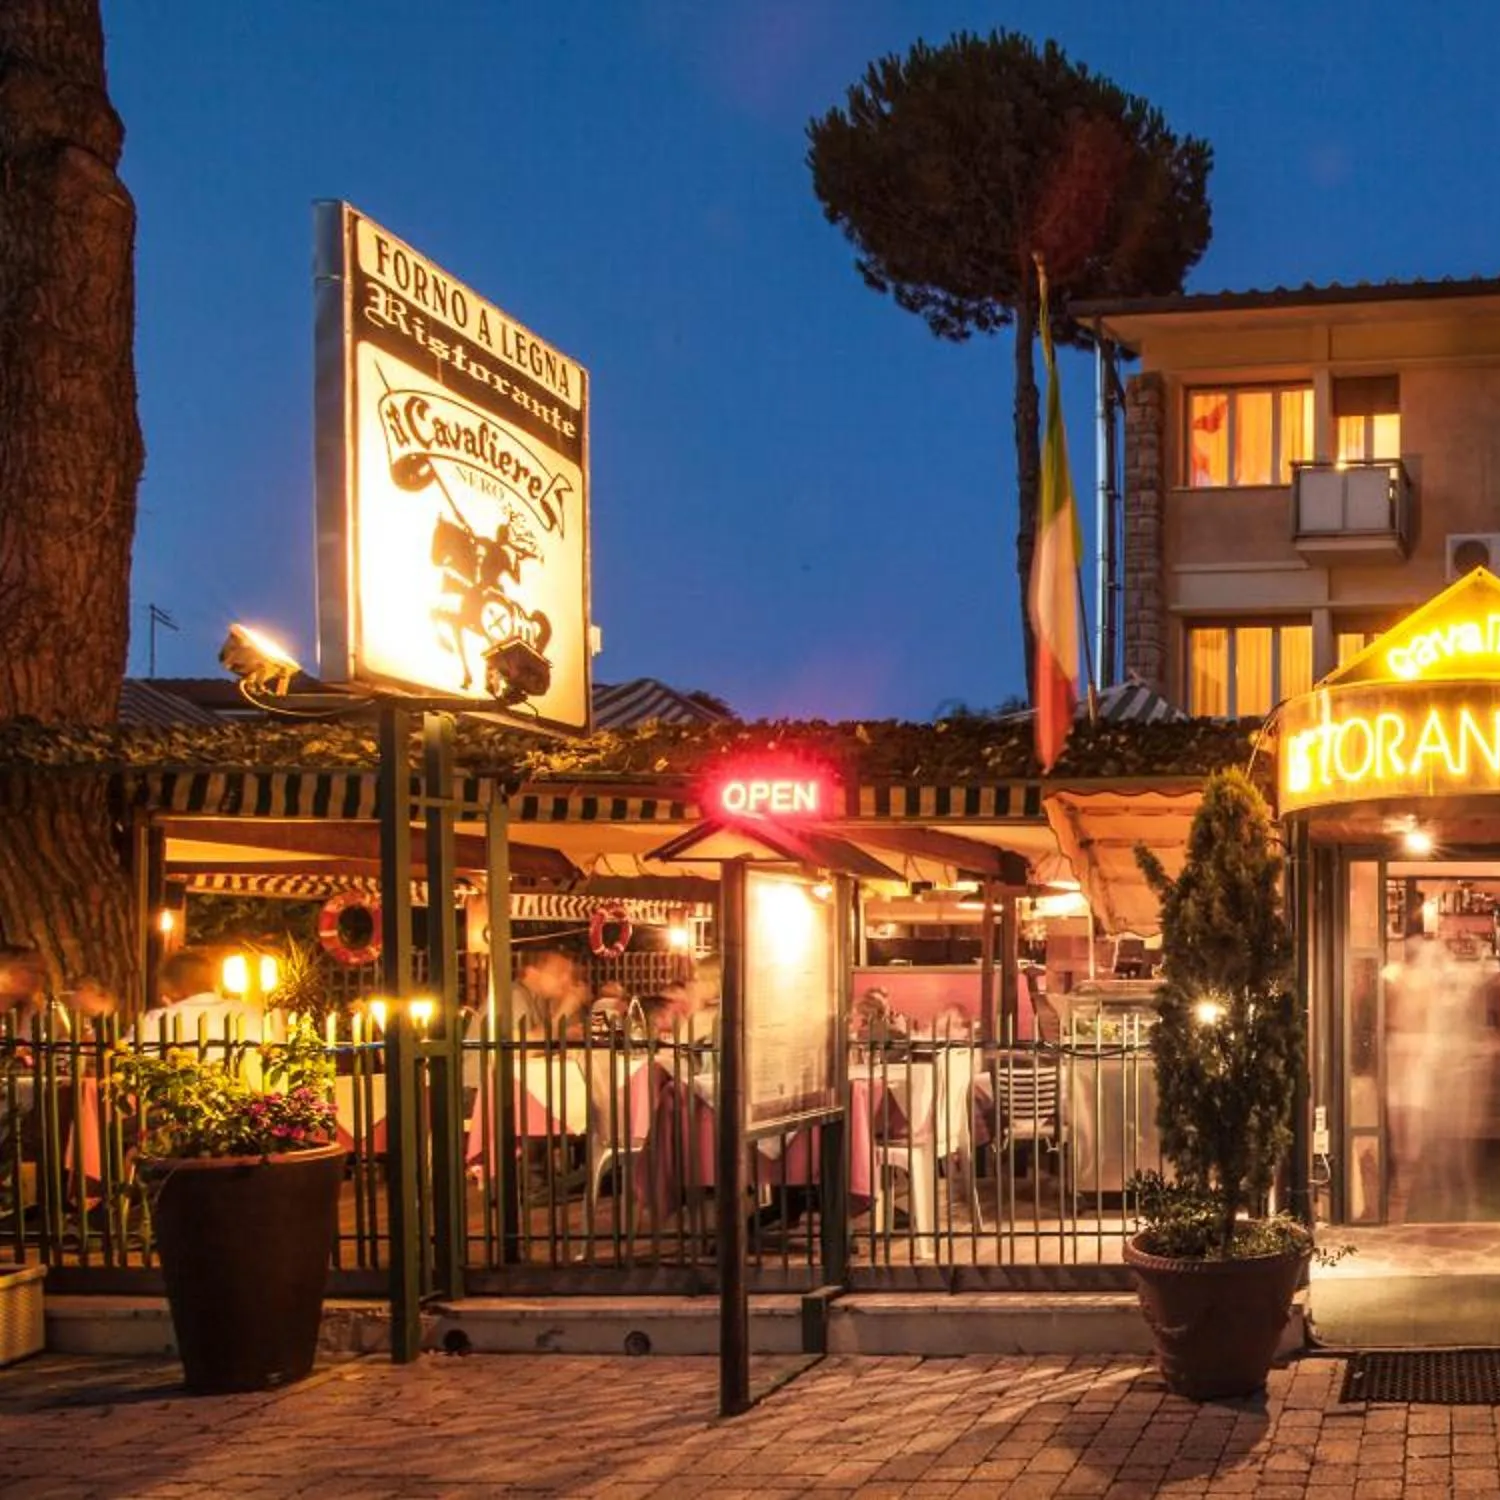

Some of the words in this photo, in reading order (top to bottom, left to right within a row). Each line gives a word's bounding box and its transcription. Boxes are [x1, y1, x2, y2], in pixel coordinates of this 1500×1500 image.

[363, 280, 577, 439] Ristorante
[374, 233, 469, 330] FORNO
[477, 306, 494, 348] A
[501, 322, 572, 400] LEGNA
[403, 395, 543, 501] Cavaliere
[455, 464, 506, 501] NERO
[721, 781, 819, 812] OPEN
